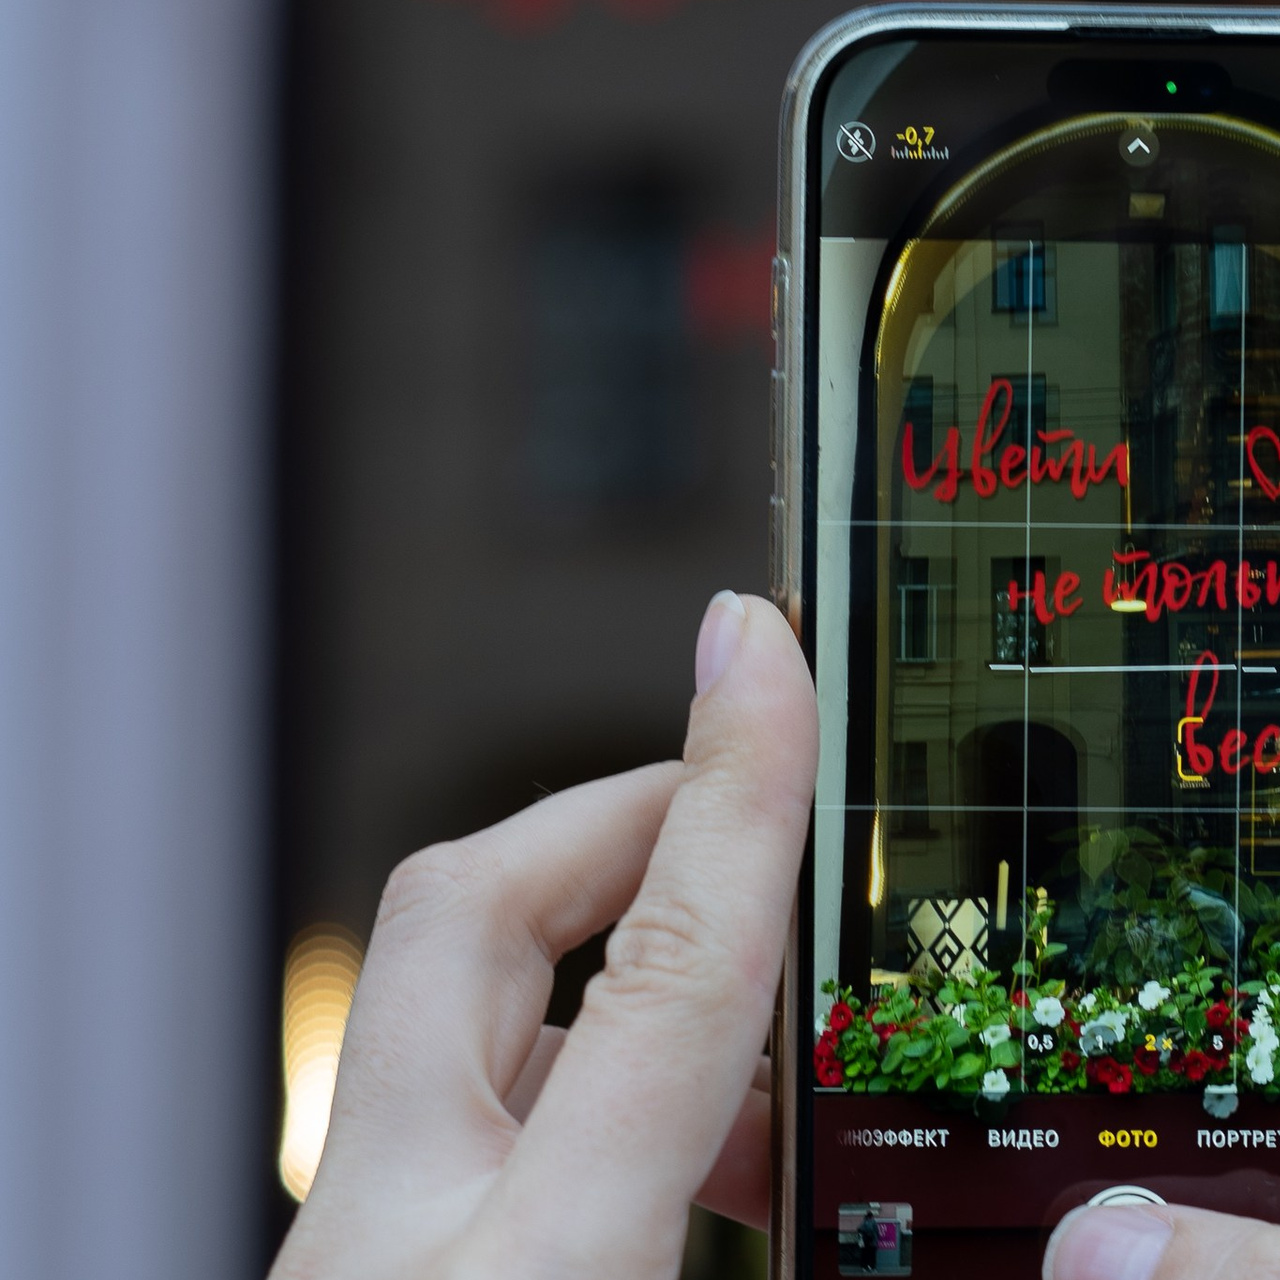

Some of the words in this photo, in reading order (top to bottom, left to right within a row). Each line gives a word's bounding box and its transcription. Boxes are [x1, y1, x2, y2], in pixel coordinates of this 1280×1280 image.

[896, 126, 935, 147] -0,7
[1008, 570, 1084, 625] не
[1027, 1033, 1054, 1053] 0,5
[1095, 1034, 1104, 1051] 1
[1212, 1034, 1224, 1051] 5
[988, 1129, 1060, 1150] ВИДЕО
[1098, 1129, 1159, 1148] ФОТО
